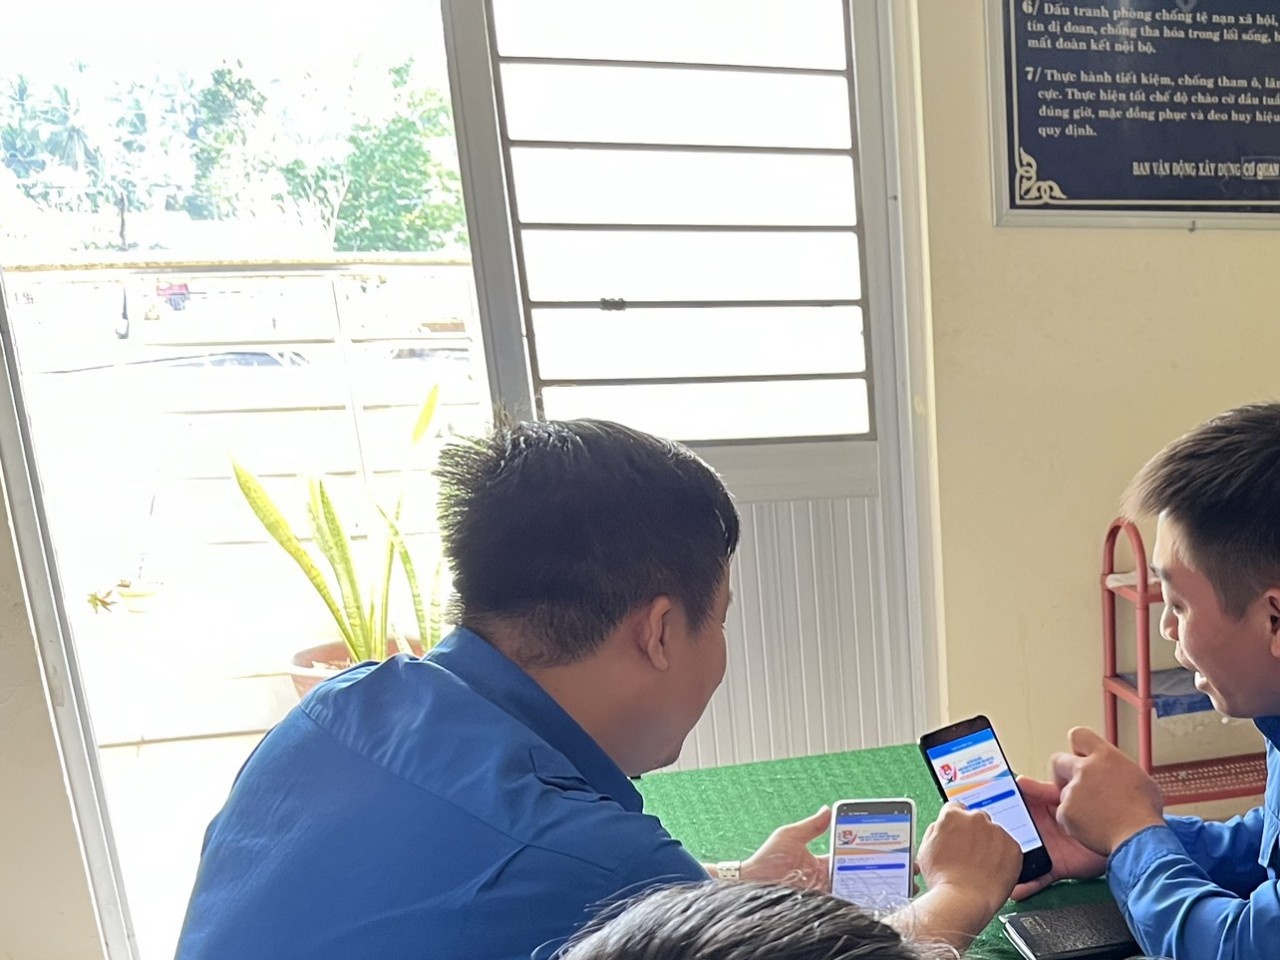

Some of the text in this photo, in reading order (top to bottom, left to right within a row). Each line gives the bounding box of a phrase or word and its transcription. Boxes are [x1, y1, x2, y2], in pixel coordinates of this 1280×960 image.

[1074, 6, 1109, 18] tranh
[1113, 6, 1152, 21] phòng
[1155, 8, 1192, 22] chống
[1196, 12, 1208, 24] tệ
[1212, 14, 1235, 26] nạn
[1239, 13, 1252, 25] xã
[1257, 13, 1279, 27] hội,
[1027, 20, 1044, 32] tín
[1100, 22, 1137, 38] chống
[1140, 25, 1160, 37] tha
[1163, 26, 1185, 38] hóa
[1188, 28, 1220, 42] trong
[1242, 29, 1271, 44] sống,
[1028, 35, 1051, 48] mất
[1090, 38, 1111, 51] kết
[1114, 41, 1134, 53] nội
[1138, 41, 1156, 54] bộ.
[1025, 66, 1041, 82] 7/
[1044, 70, 1077, 83] Thực
[1080, 70, 1112, 83] hành
[1116, 71, 1137, 83] tiết
[1141, 72, 1175, 86] kiệm,
[1178, 73, 1214, 88] chống
[1218, 76, 1248, 87] tham
[1251, 77, 1262, 89] ô,
[1038, 89, 1063, 101] cực.
[1065, 88, 1096, 102] Thực
[1100, 90, 1126, 102] hiện
[1130, 90, 1145, 101] tốt
[1150, 90, 1171, 102] chế
[1191, 92, 1219, 104] chào
[1222, 93, 1235, 104] cờ
[1073, 106, 1095, 119] giờ,
[1099, 108, 1122, 120] mặc
[1158, 108, 1187, 122] phục
[1190, 110, 1204, 120] và
[1231, 110, 1251, 124] huy
[1255, 110, 1280, 123] hiệu
[1038, 126, 1061, 138] quy
[1133, 162, 1150, 175] BAN
[1199, 159, 1216, 176] XÂY
[1218, 162, 1241, 180] DỰNG
